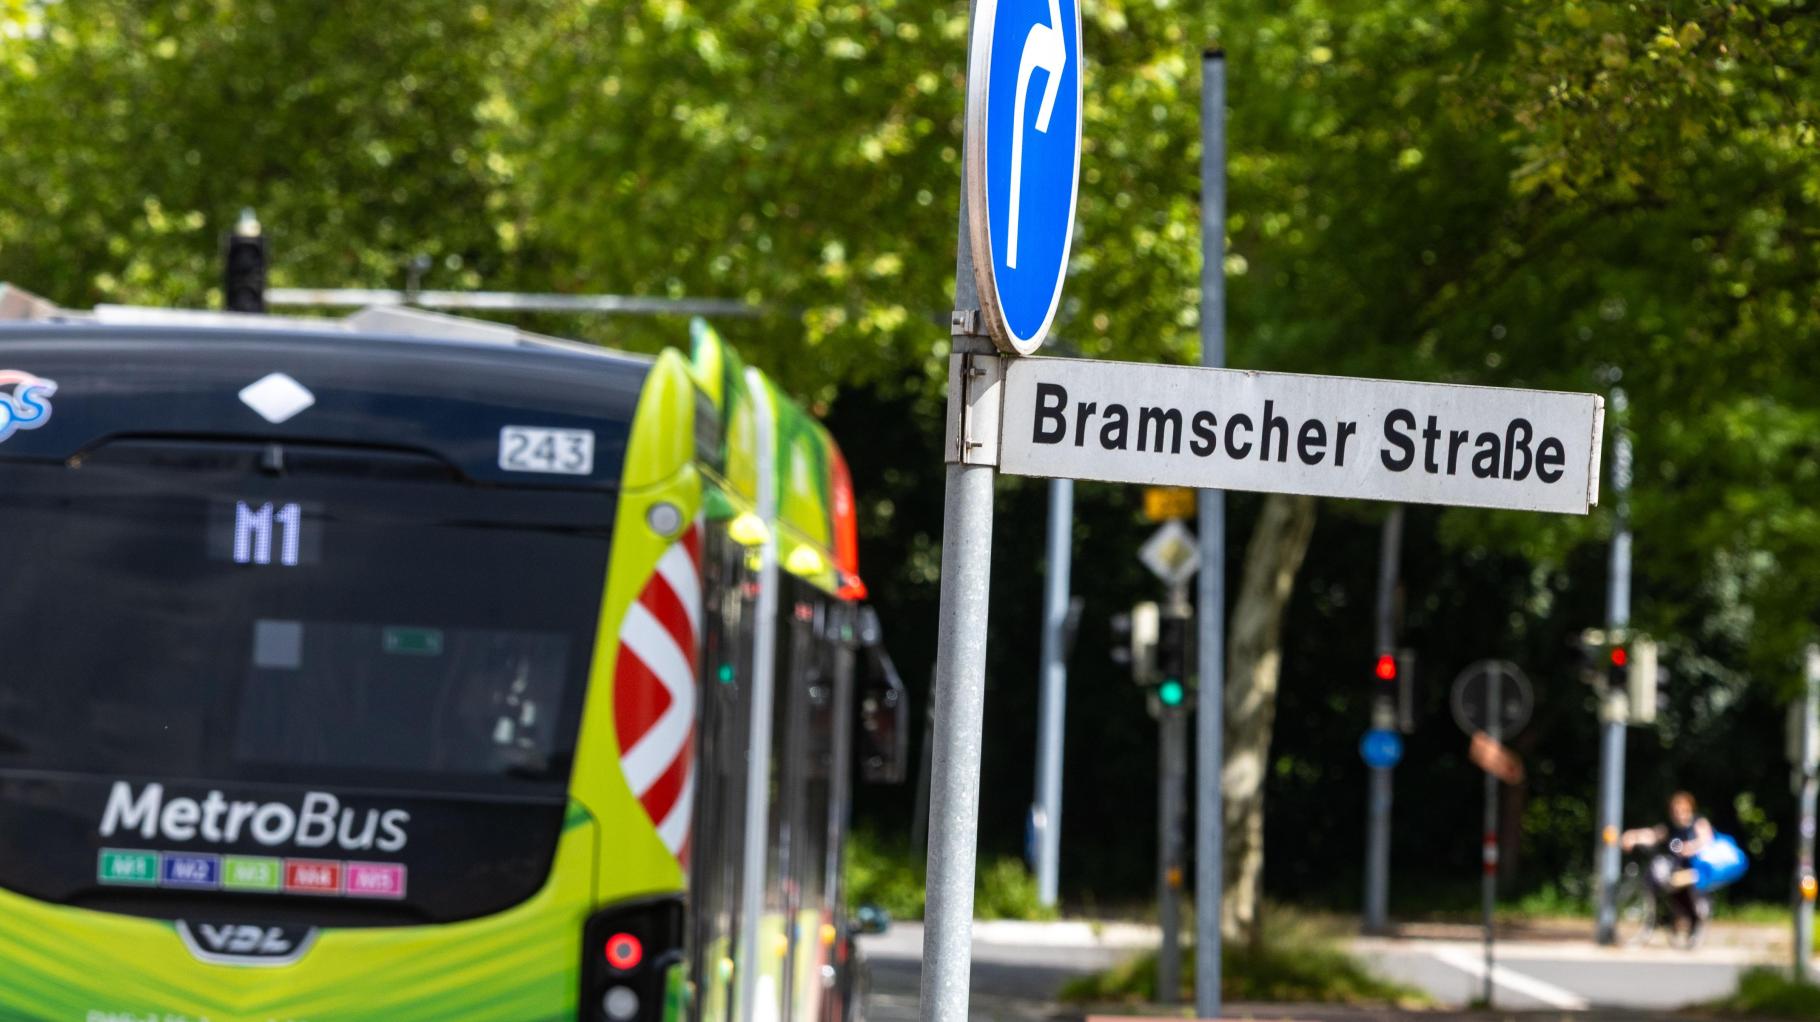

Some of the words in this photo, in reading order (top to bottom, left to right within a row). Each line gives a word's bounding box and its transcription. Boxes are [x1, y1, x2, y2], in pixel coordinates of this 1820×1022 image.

[506, 432, 586, 472] 243
[1032, 381, 1356, 467] Bramscher
[1380, 408, 1566, 484] Straße
[233, 500, 300, 566] M1
[100, 780, 410, 852] MetroBus
[113, 854, 147, 876] M1
[171, 859, 210, 880] M2
[200, 923, 292, 952] VDL
